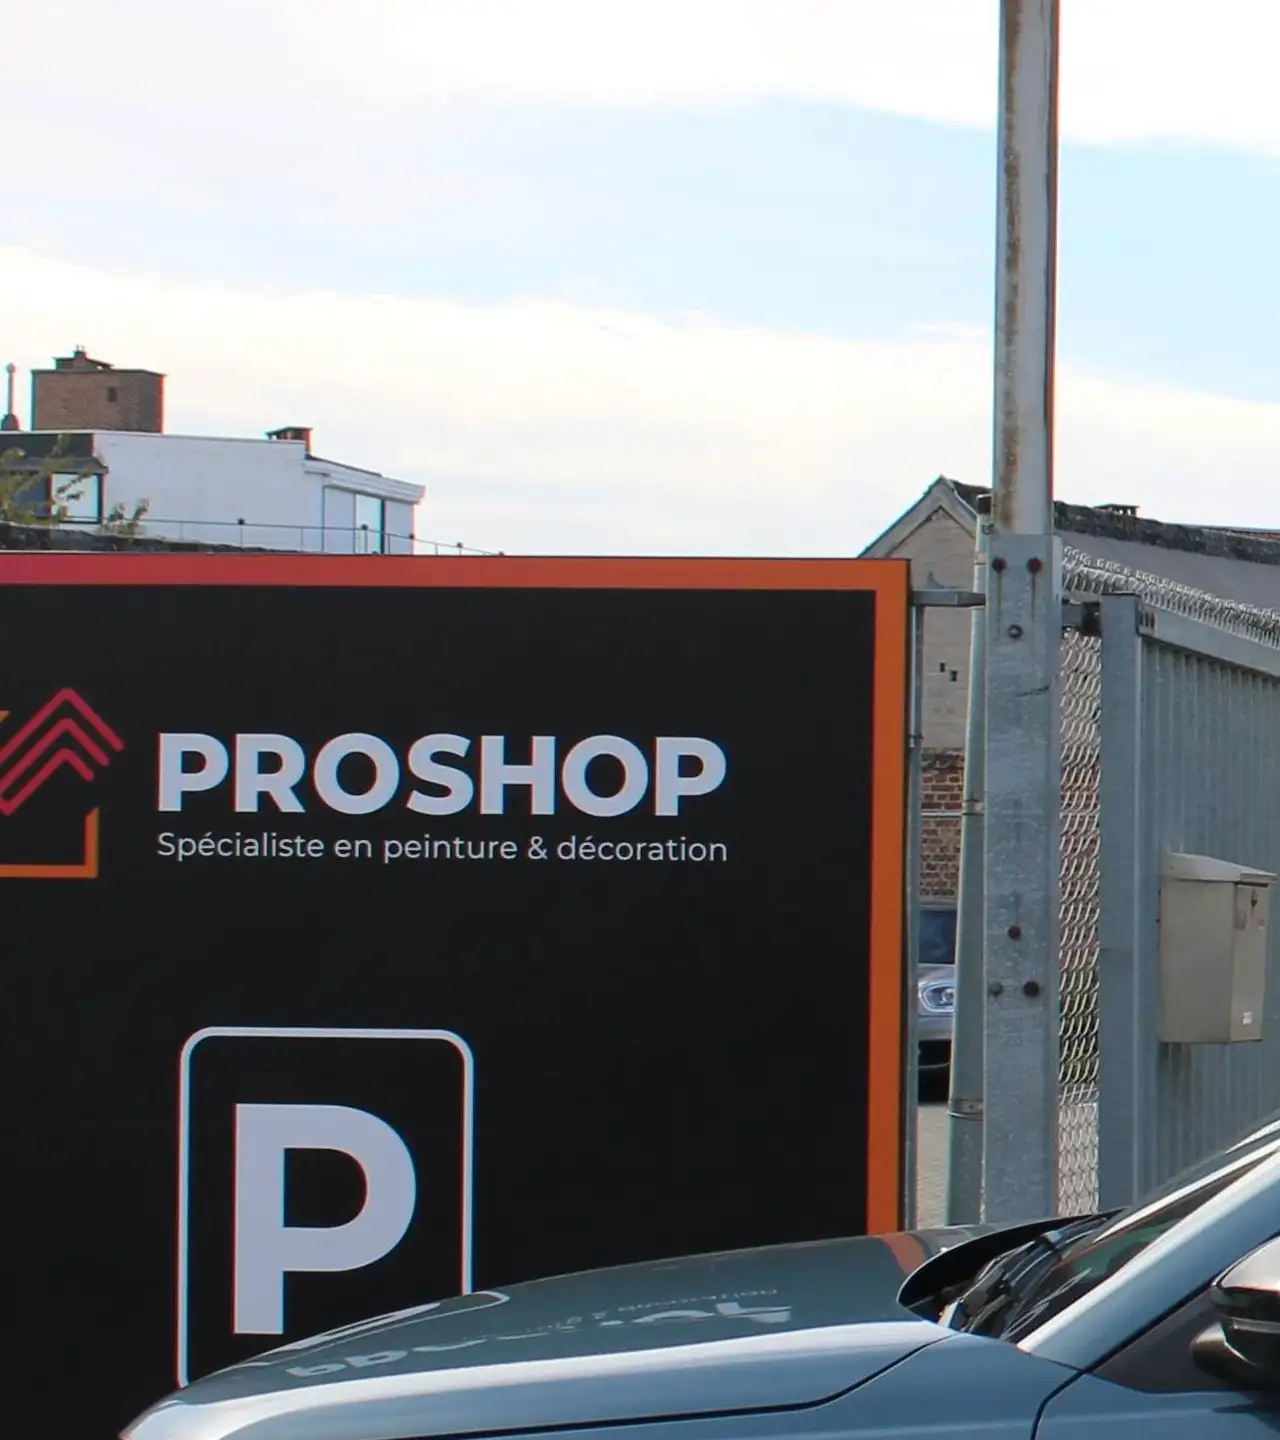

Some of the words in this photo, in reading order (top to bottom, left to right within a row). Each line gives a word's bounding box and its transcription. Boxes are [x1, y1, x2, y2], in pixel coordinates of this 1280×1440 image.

[157, 732, 727, 817] PROSHOP
[157, 831, 325, 862] Spécialiste
[334, 840, 372, 858] en
[384, 833, 518, 864] peinture
[528, 836, 548, 860] &
[557, 834, 727, 862] décoration
[233, 1103, 417, 1335] P
